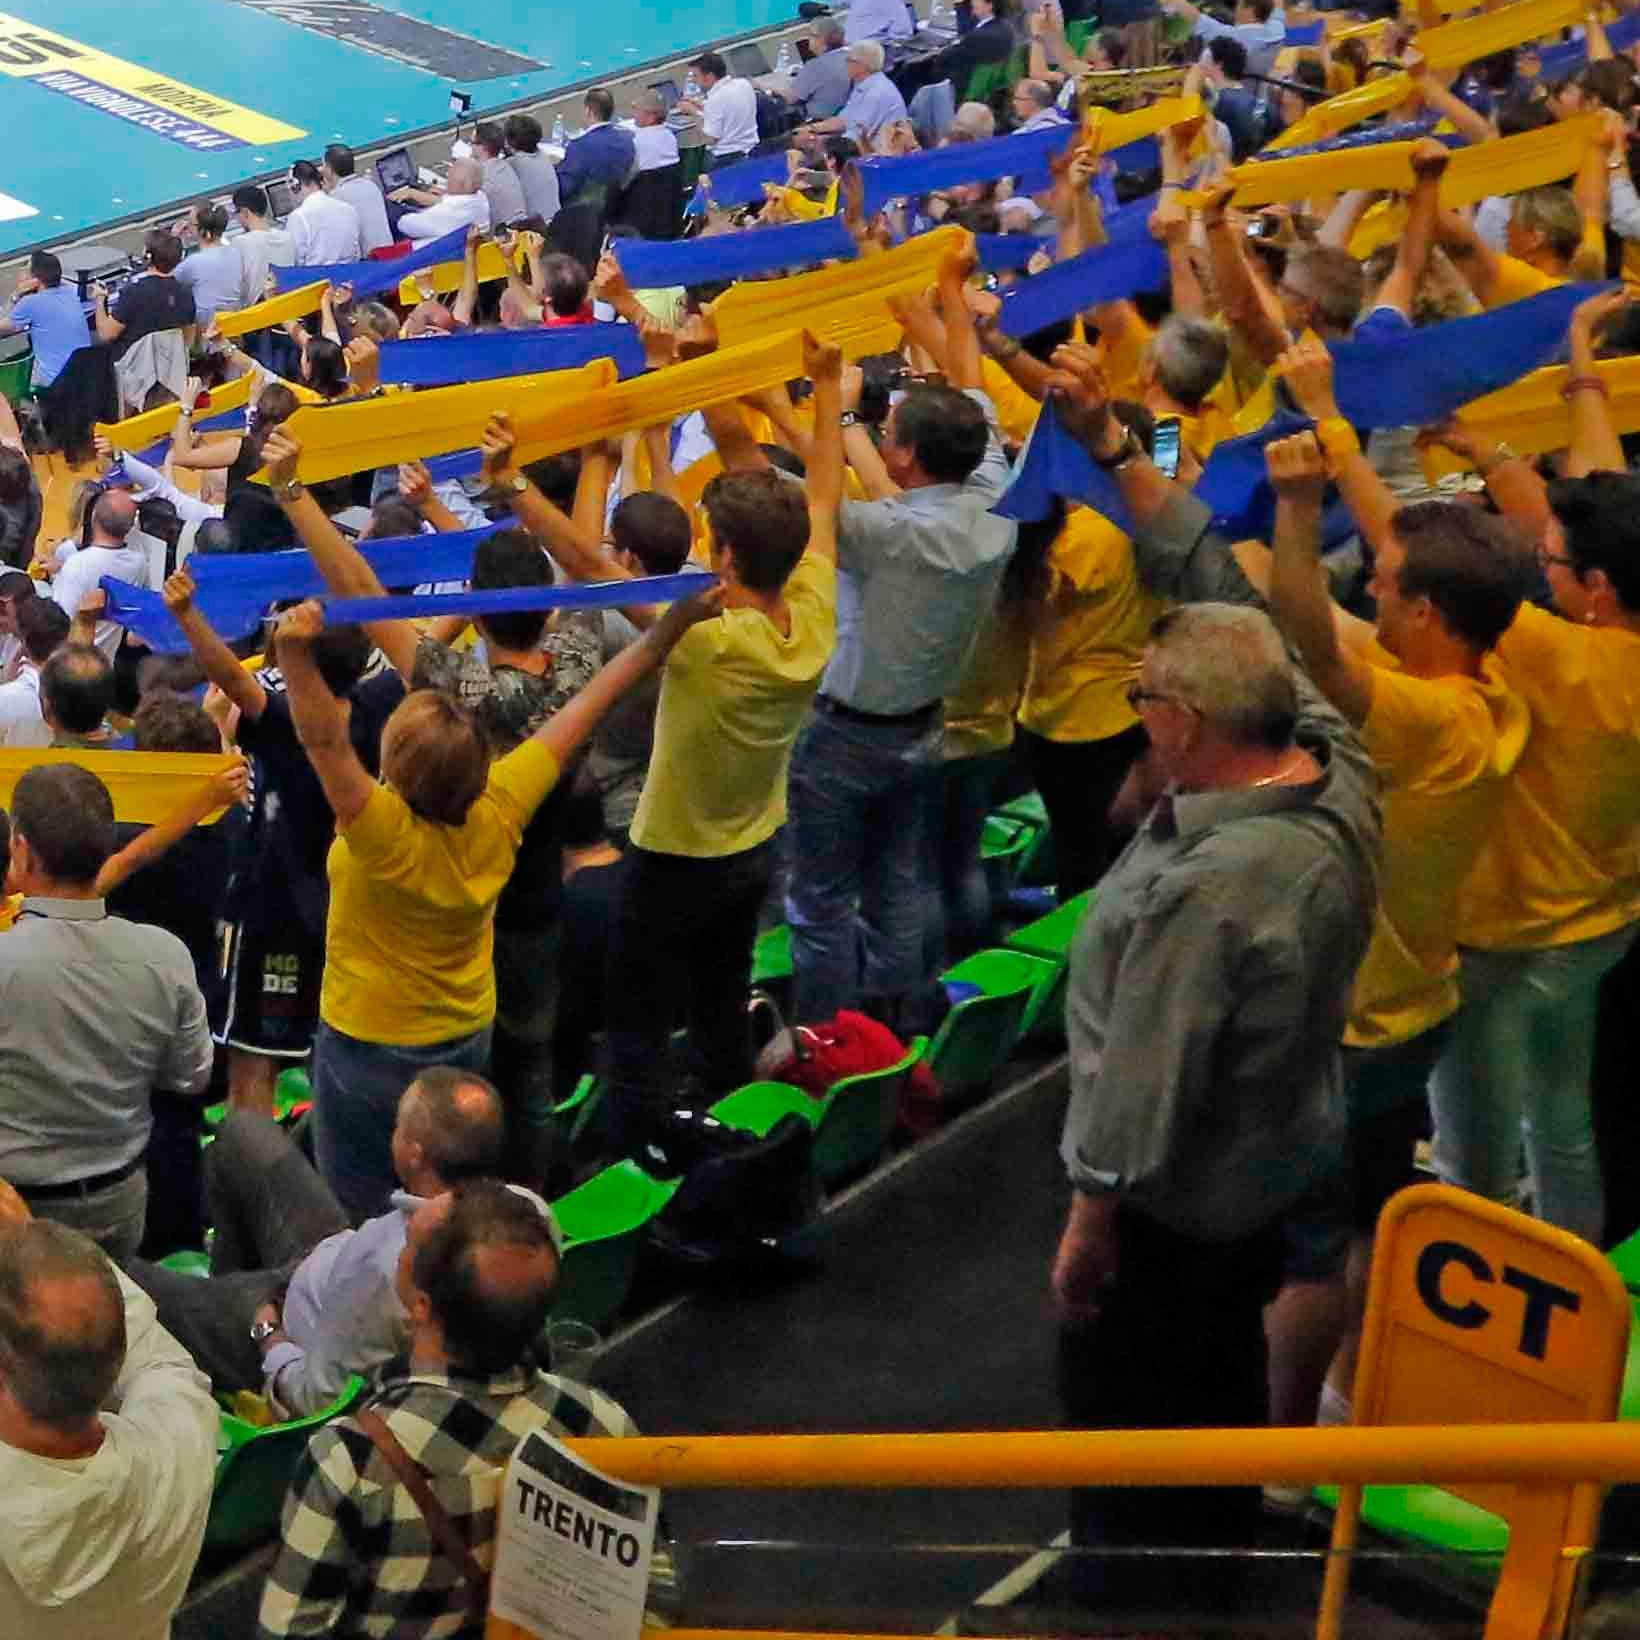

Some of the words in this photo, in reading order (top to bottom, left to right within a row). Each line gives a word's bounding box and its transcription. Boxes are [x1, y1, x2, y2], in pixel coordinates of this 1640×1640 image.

[35, 71, 85, 93] VIA
[78, 85, 180, 132] VIGNOLESE
[133, 81, 233, 119] MODENA
[263, 974, 298, 995] DE
[1413, 1239, 1581, 1363] CT
[516, 1477, 639, 1569] TRENTO
